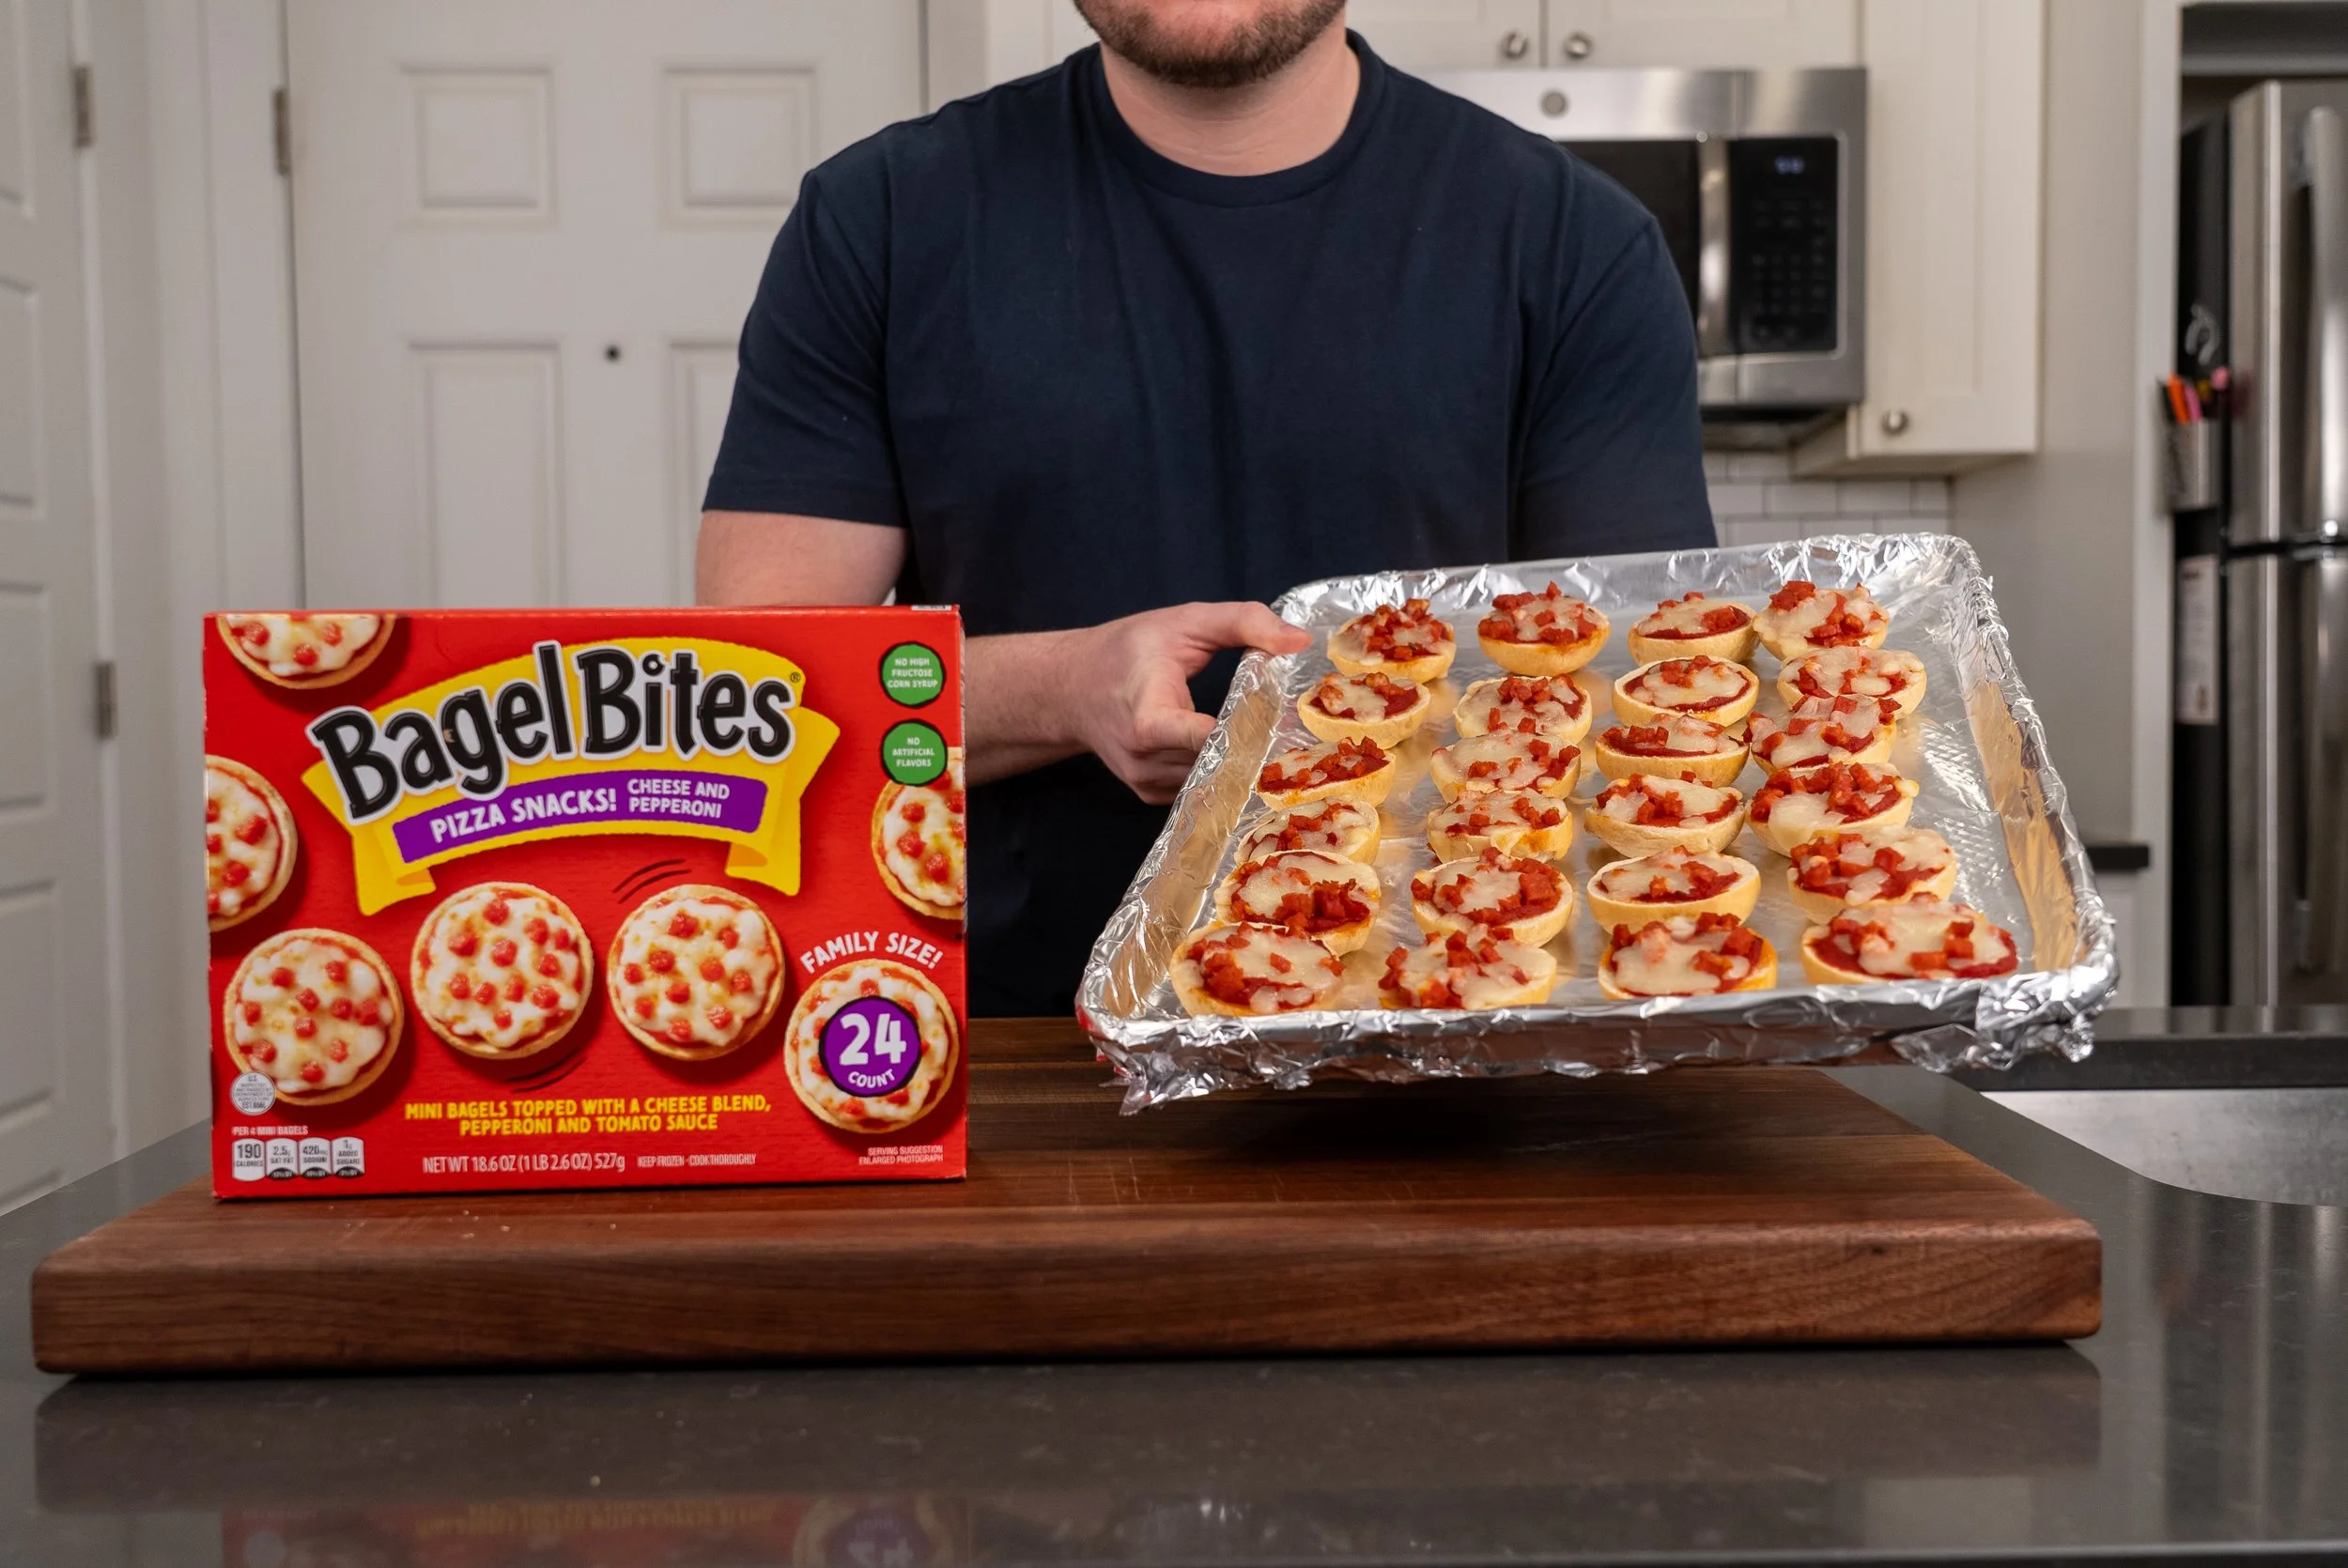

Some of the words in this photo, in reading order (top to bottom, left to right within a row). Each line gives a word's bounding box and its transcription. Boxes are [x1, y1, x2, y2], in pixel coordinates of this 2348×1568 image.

[888, 680, 910, 688] CORN
[912, 680, 938, 688] SYRUP
[891, 669, 933, 678] FRUCTOSE
[307, 642, 575, 822] Bagel
[575, 646, 793, 759] Bites
[896, 759, 932, 767] FLAVORS
[626, 778, 691, 795] CHEESE
[695, 781, 731, 800] AND
[429, 803, 506, 844] PIZZA
[510, 787, 618, 823] SNACKS!
[628, 797, 722, 819] PEPPERONI
[799, 930, 879, 975] FAMILY
[885, 932, 944, 970] SIZE!
[839, 1012, 907, 1066] 24
[847, 1068, 896, 1089] COUNT
[405, 1102, 443, 1120] MINI
[446, 1100, 508, 1119] BAGELS
[511, 1099, 578, 1117] TOPPED
[581, 1099, 626, 1115] WITH
[629, 1098, 641, 1114] A
[644, 1096, 708, 1114] CHEESE
[712, 1094, 771, 1113] BLEND,
[232, 1126, 249, 1136] PER
[256, 1126, 276, 1136] MINI
[277, 1125, 309, 1136] BAGELS
[459, 1117, 552, 1136] PEPPERONI
[556, 1116, 592, 1133] AND
[595, 1115, 662, 1133] TOMATO
[666, 1114, 718, 1130] SAUCE
[238, 1144, 261, 1159] 190
[637, 1156, 657, 1168] KEEP
[657, 1155, 685, 1167] FROZEN
[687, 1154, 709, 1166] COOK
[709, 1153, 757, 1165] THOROUGHLY
[858, 1156, 896, 1165] ENLARGED
[896, 1154, 944, 1163] PHOTOGRAPH
[868, 1146, 899, 1156] SERVING
[899, 1145, 944, 1154] SUGGESTION
[423, 1156, 447, 1174] NET
[448, 1156, 469, 1172] WT
[471, 1156, 498, 1173] 18.6
[499, 1154, 517, 1171] OZ
[517, 1154, 530, 1173] (1
[533, 1154, 549, 1171] LB
[550, 1154, 569, 1171] 2.6
[570, 1152, 593, 1172] OZ)
[595, 1152, 626, 1173] 527g
